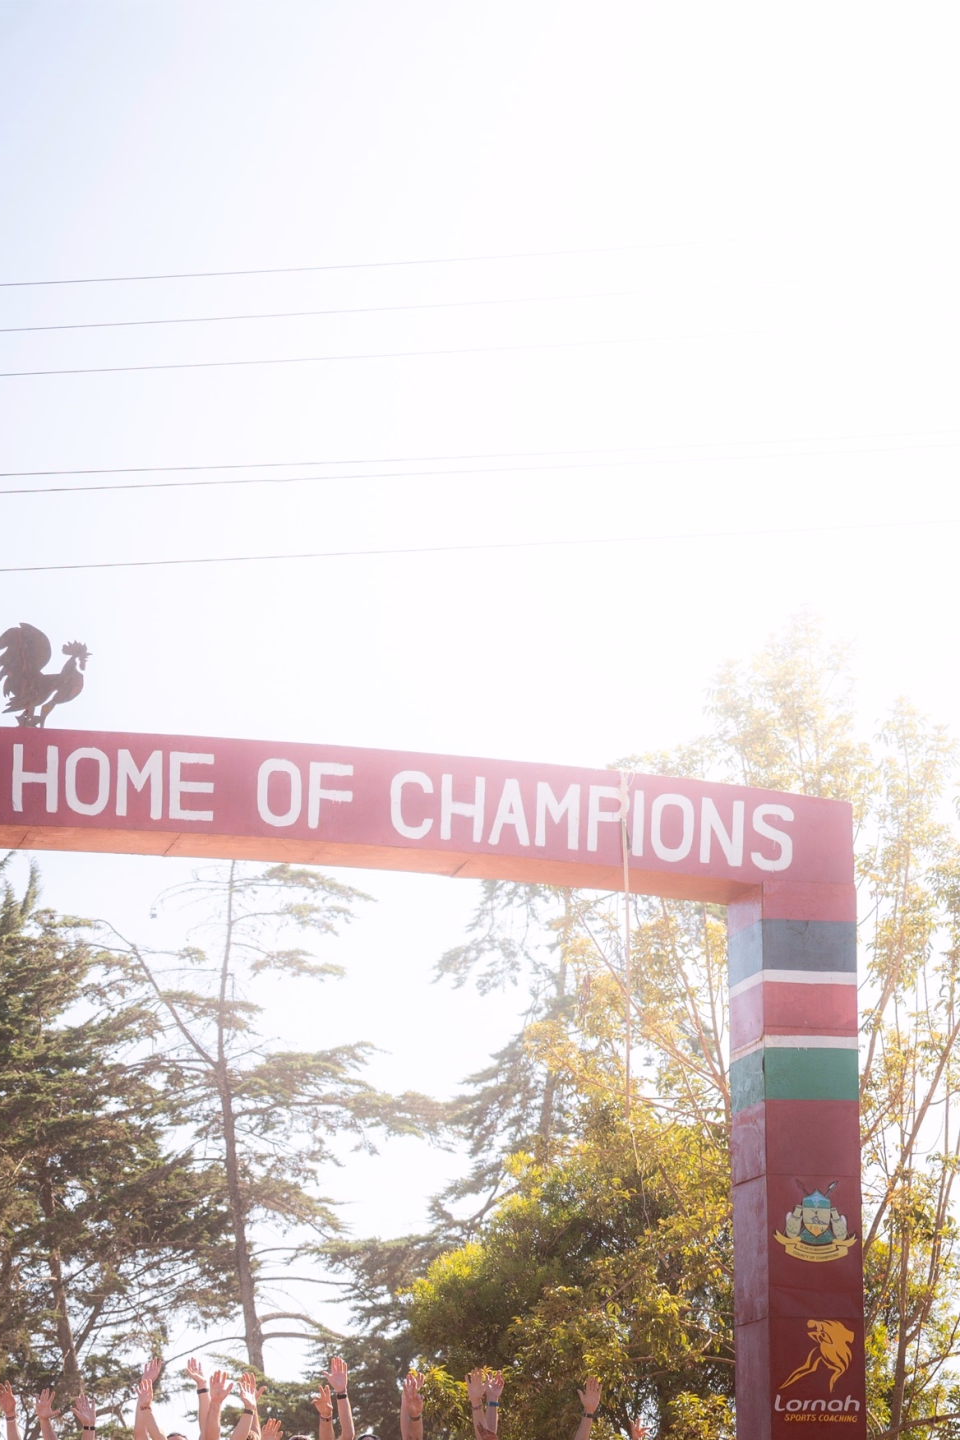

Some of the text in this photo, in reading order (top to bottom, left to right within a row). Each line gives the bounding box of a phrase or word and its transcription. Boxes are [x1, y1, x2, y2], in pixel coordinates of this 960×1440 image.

[12, 743, 215, 821] HOME
[257, 757, 353, 829] OF
[390, 769, 795, 872] CHAMPIONS
[792, 1250, 809, 1259] COUNTY
[774, 1394, 861, 1412] Lornah
[784, 1413, 858, 1423] SPORTS COACHING
